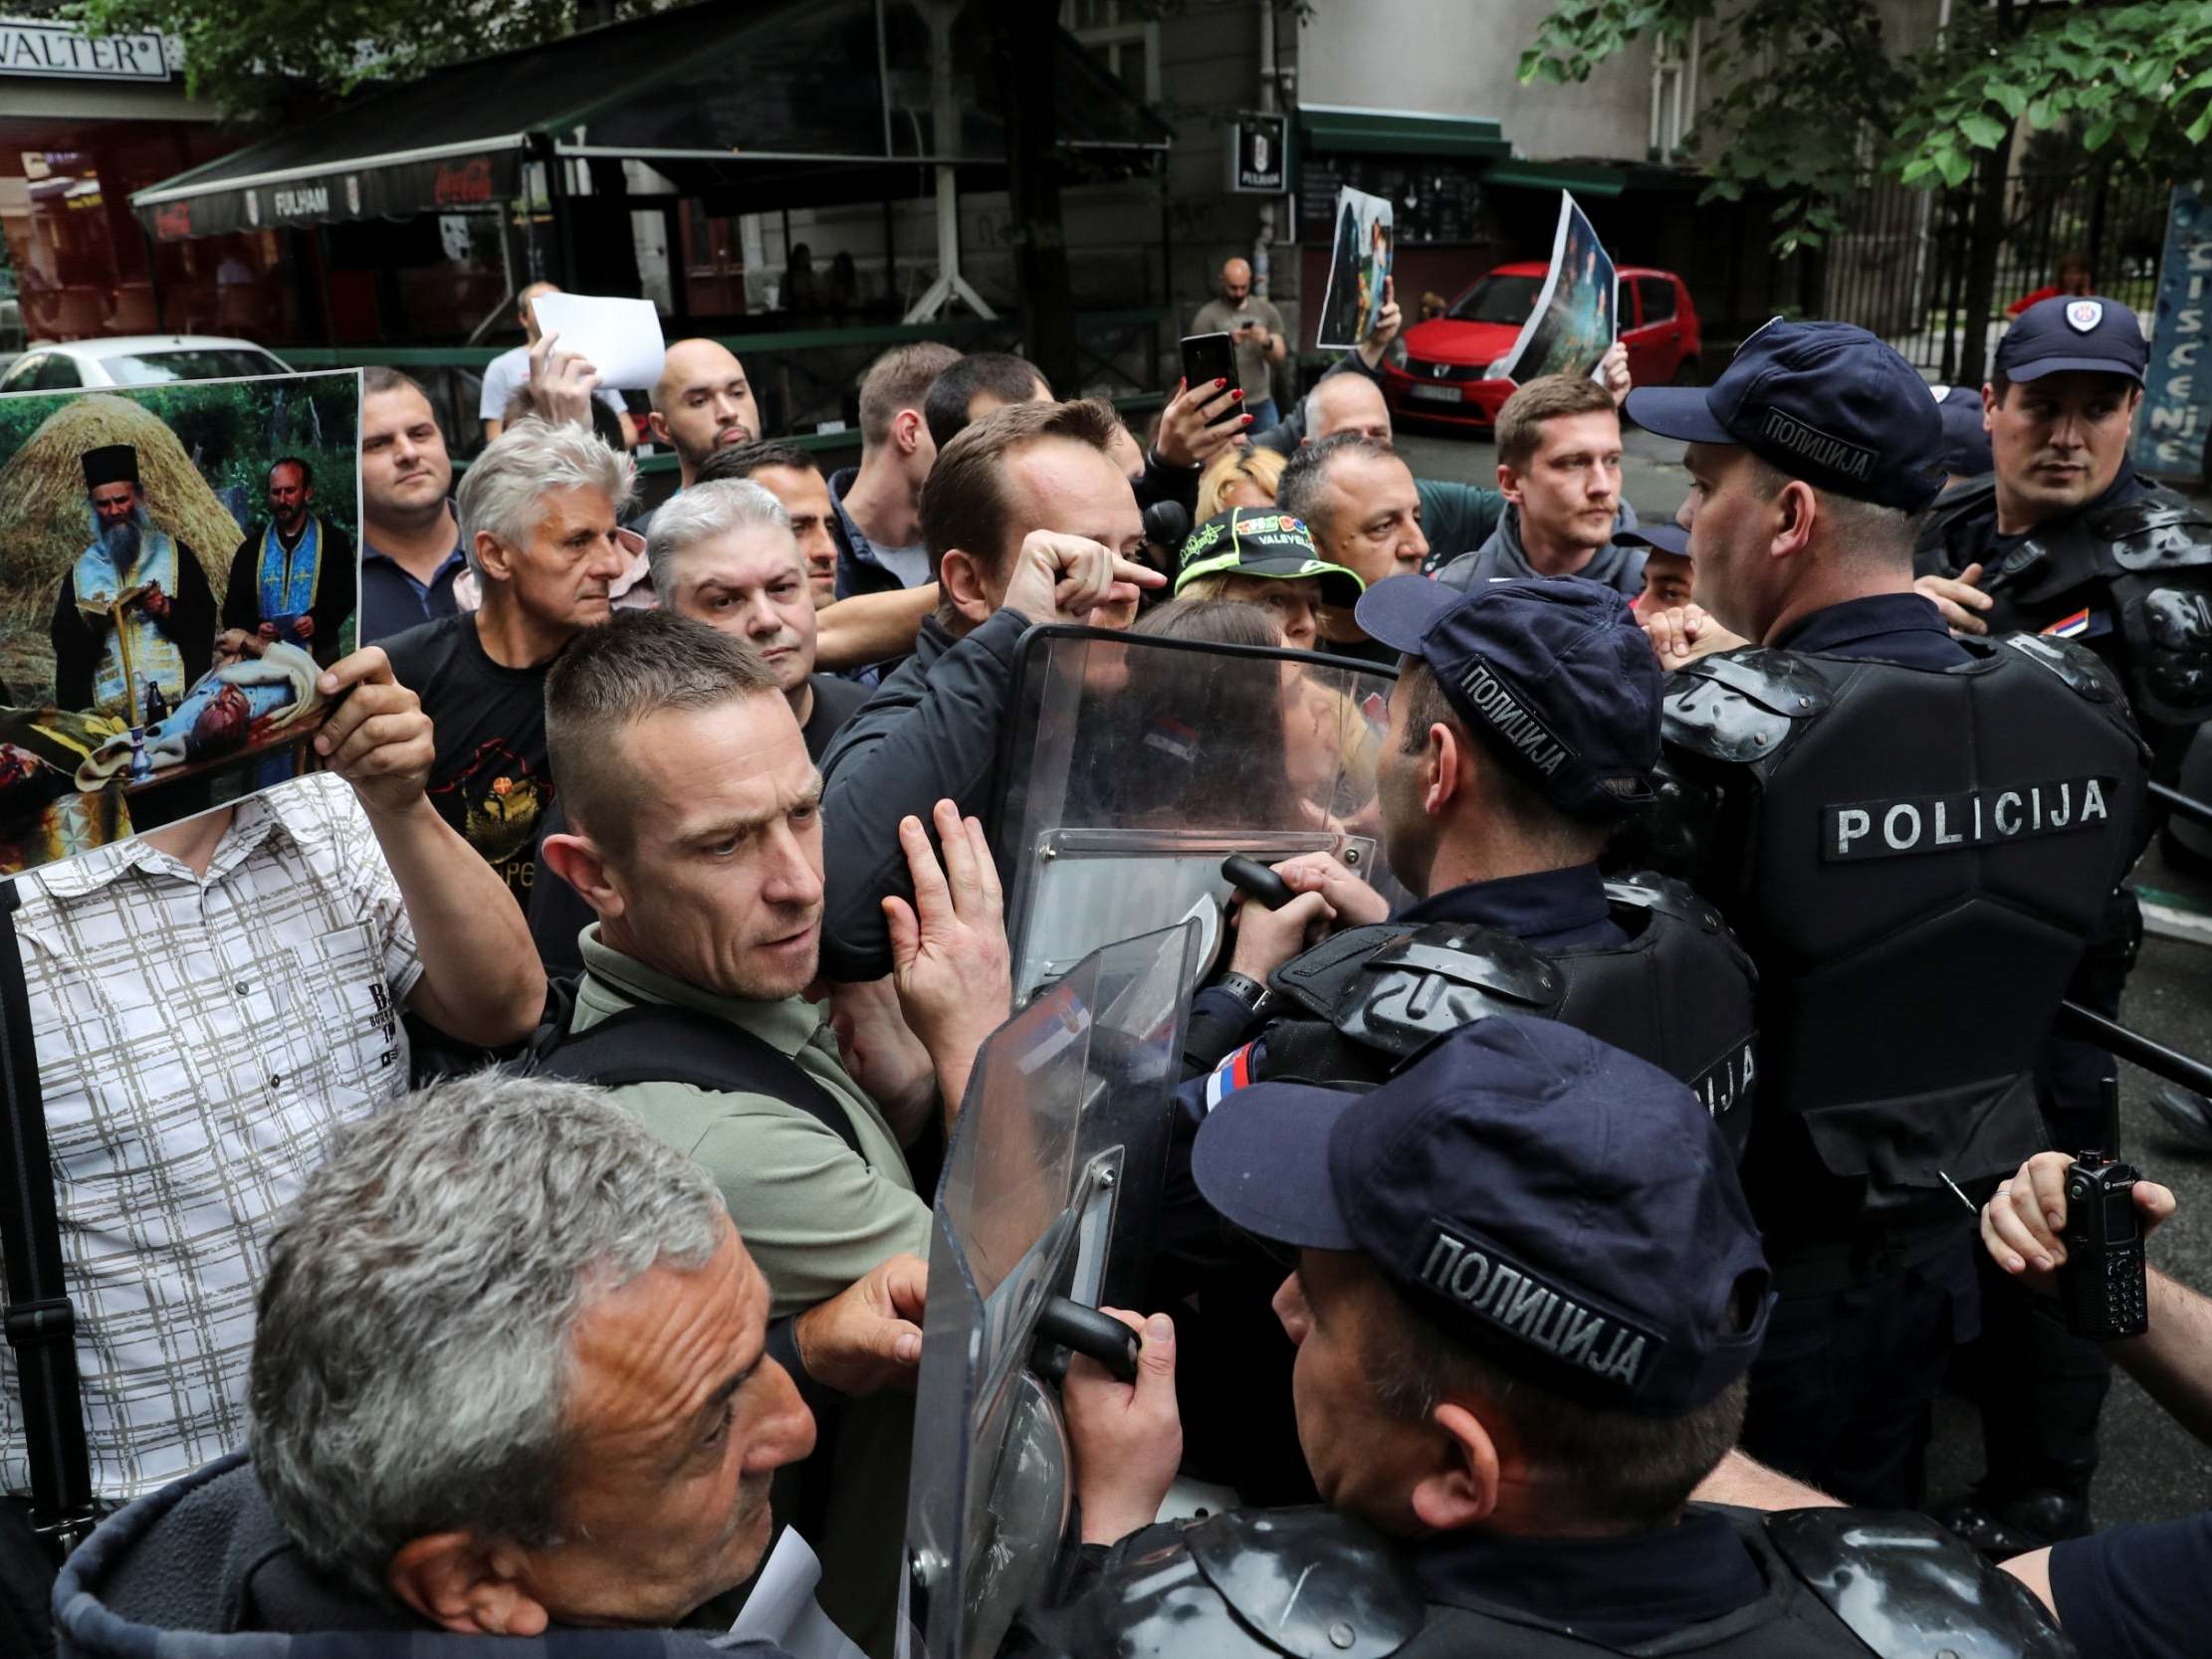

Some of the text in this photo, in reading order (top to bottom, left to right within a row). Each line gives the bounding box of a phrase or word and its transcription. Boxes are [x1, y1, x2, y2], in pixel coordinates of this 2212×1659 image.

[274, 186, 330, 216] FULHAM
[1765, 413, 1870, 478] ПОЛИЦИЈА
[1459, 665, 1567, 776] ПОЛИЦИЈА
[1838, 778, 2108, 855] POLICIJA
[1694, 1044, 1755, 1118] IJA
[1421, 1232, 1647, 1386] ПОЛИЦИЈА
